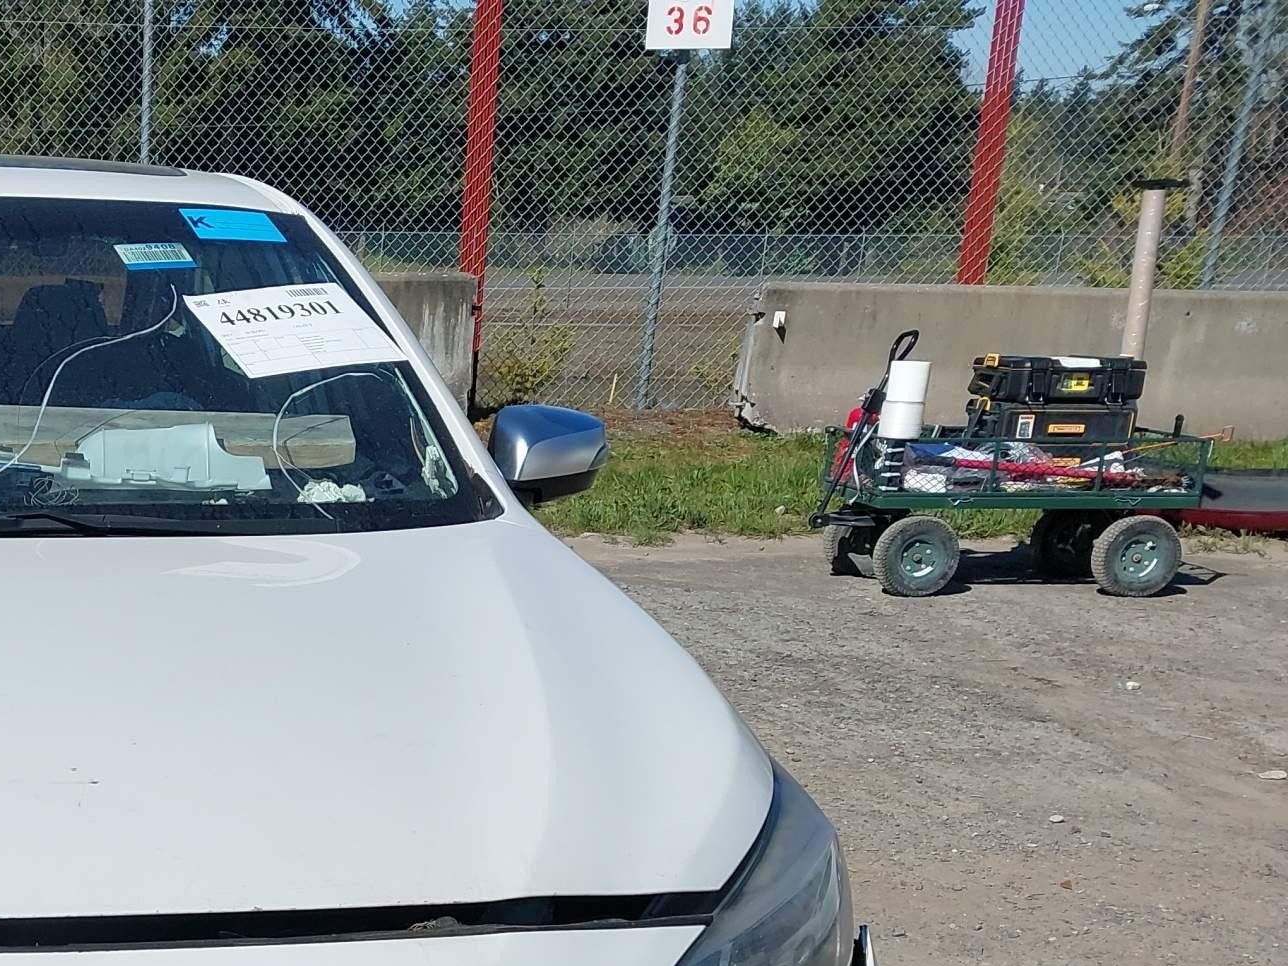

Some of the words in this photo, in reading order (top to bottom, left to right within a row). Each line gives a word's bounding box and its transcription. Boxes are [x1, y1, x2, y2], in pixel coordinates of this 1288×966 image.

[666, 6, 713, 35] 36
[187, 216, 215, 229] K
[220, 300, 343, 325] 44819301
